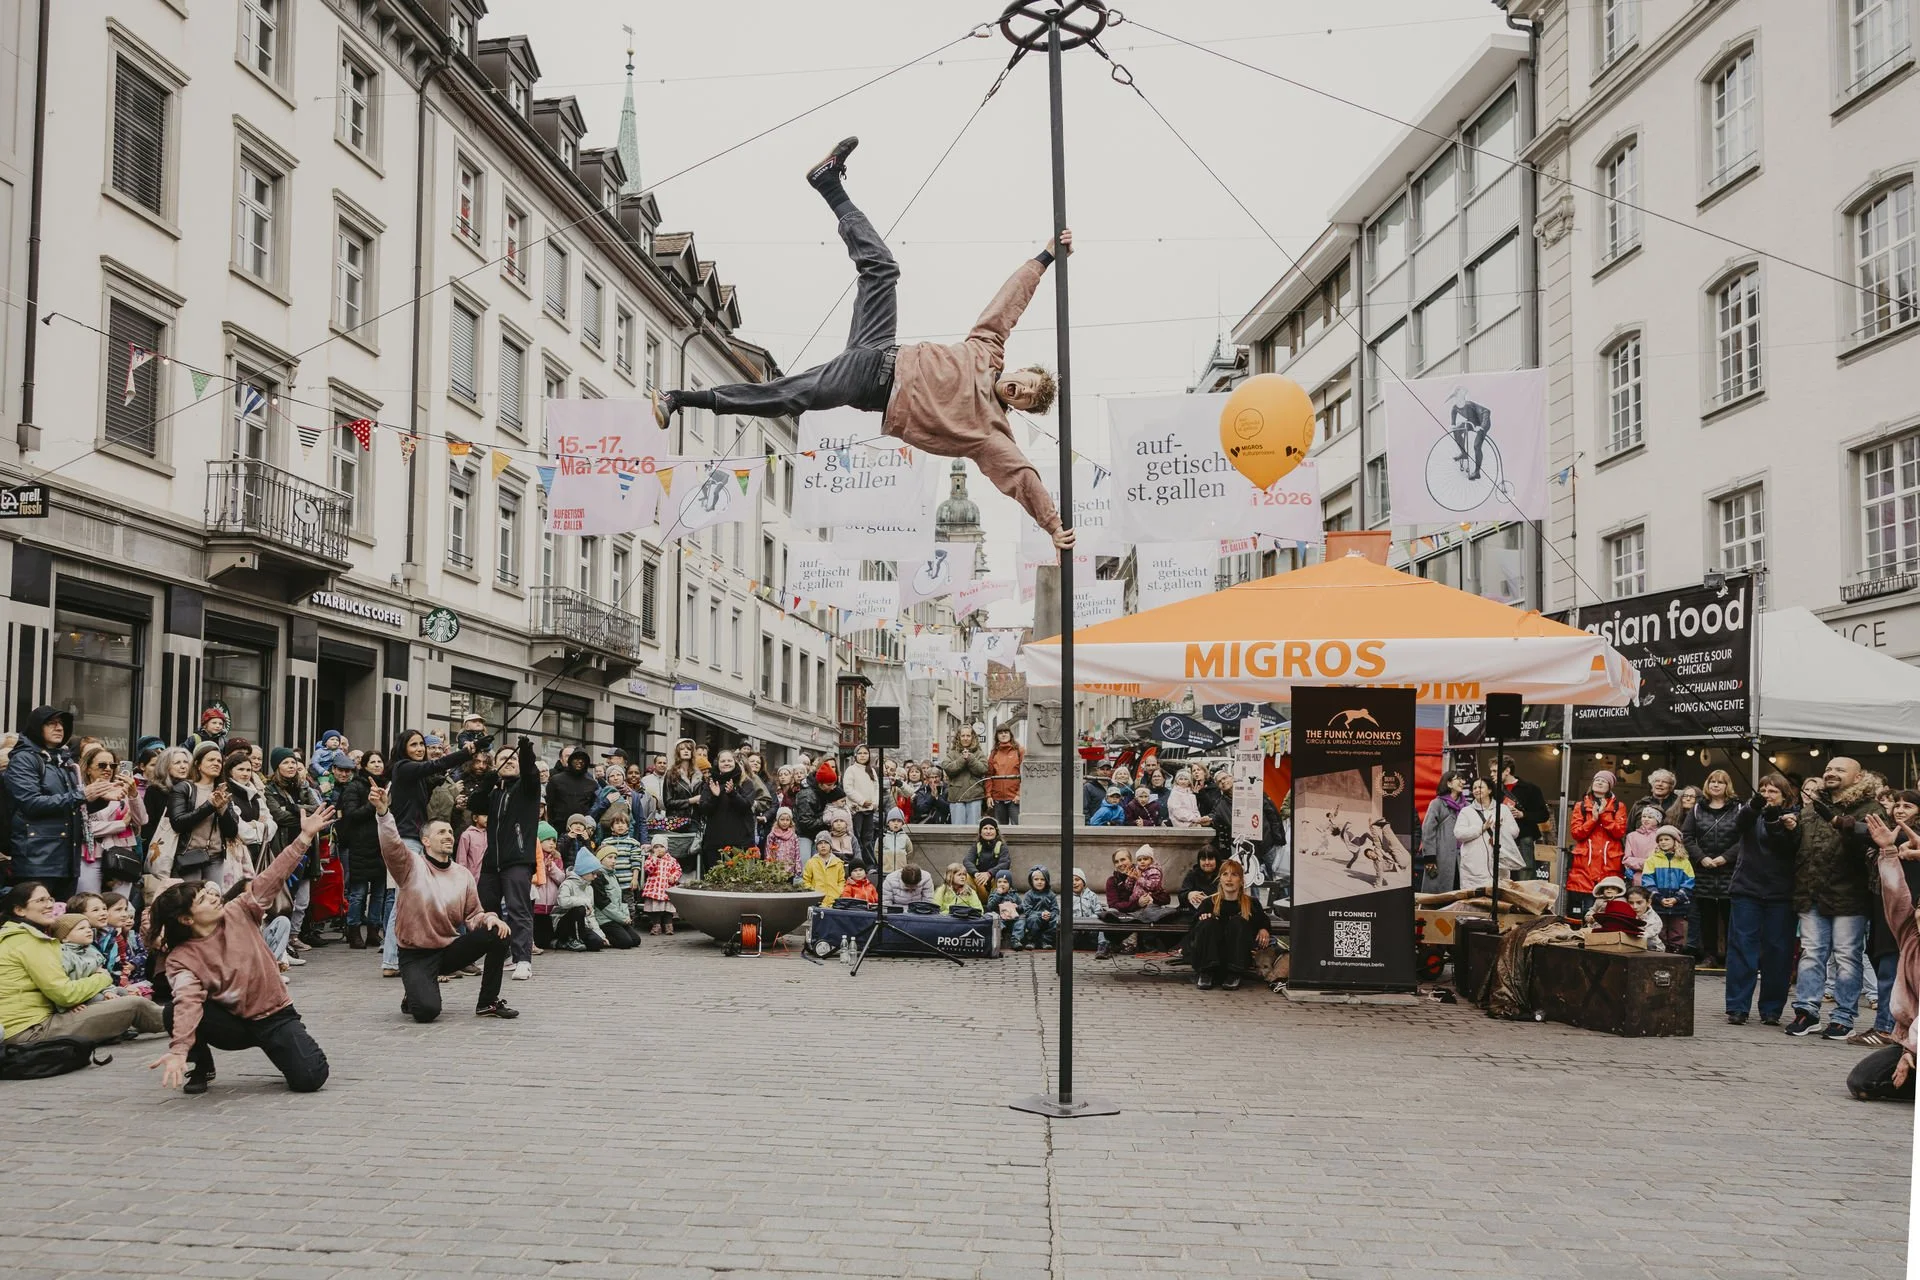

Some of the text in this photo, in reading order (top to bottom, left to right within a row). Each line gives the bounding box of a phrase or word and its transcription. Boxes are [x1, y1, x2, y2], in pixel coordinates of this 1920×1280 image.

[1136, 433, 1182, 455] auf-
[596, 456, 656, 474] 2026
[1263, 492, 1312, 505] 2026
[554, 508, 585, 519] AUFGETISCHT
[553, 520, 583, 530] ST. GALLEN
[803, 566, 850, 580] getischt
[1158, 567, 1208, 581] getischt
[312, 591, 406, 626] STARBUCKS COFFEE
[1667, 588, 1745, 640] food
[1185, 641, 1387, 679] MIGROS
[1677, 648, 1733, 665] SWEET & SOUR
[1677, 662, 1712, 676] CHICKEN
[1718, 679, 1738, 691] RIND
[1579, 707, 1629, 719] SATAY CHICKEN
[1674, 699, 1745, 713] HONG KONG ENTE
[1306, 730, 1402, 740] THE FUNKY MONKEYS
[937, 936, 985, 947] PROTENT
